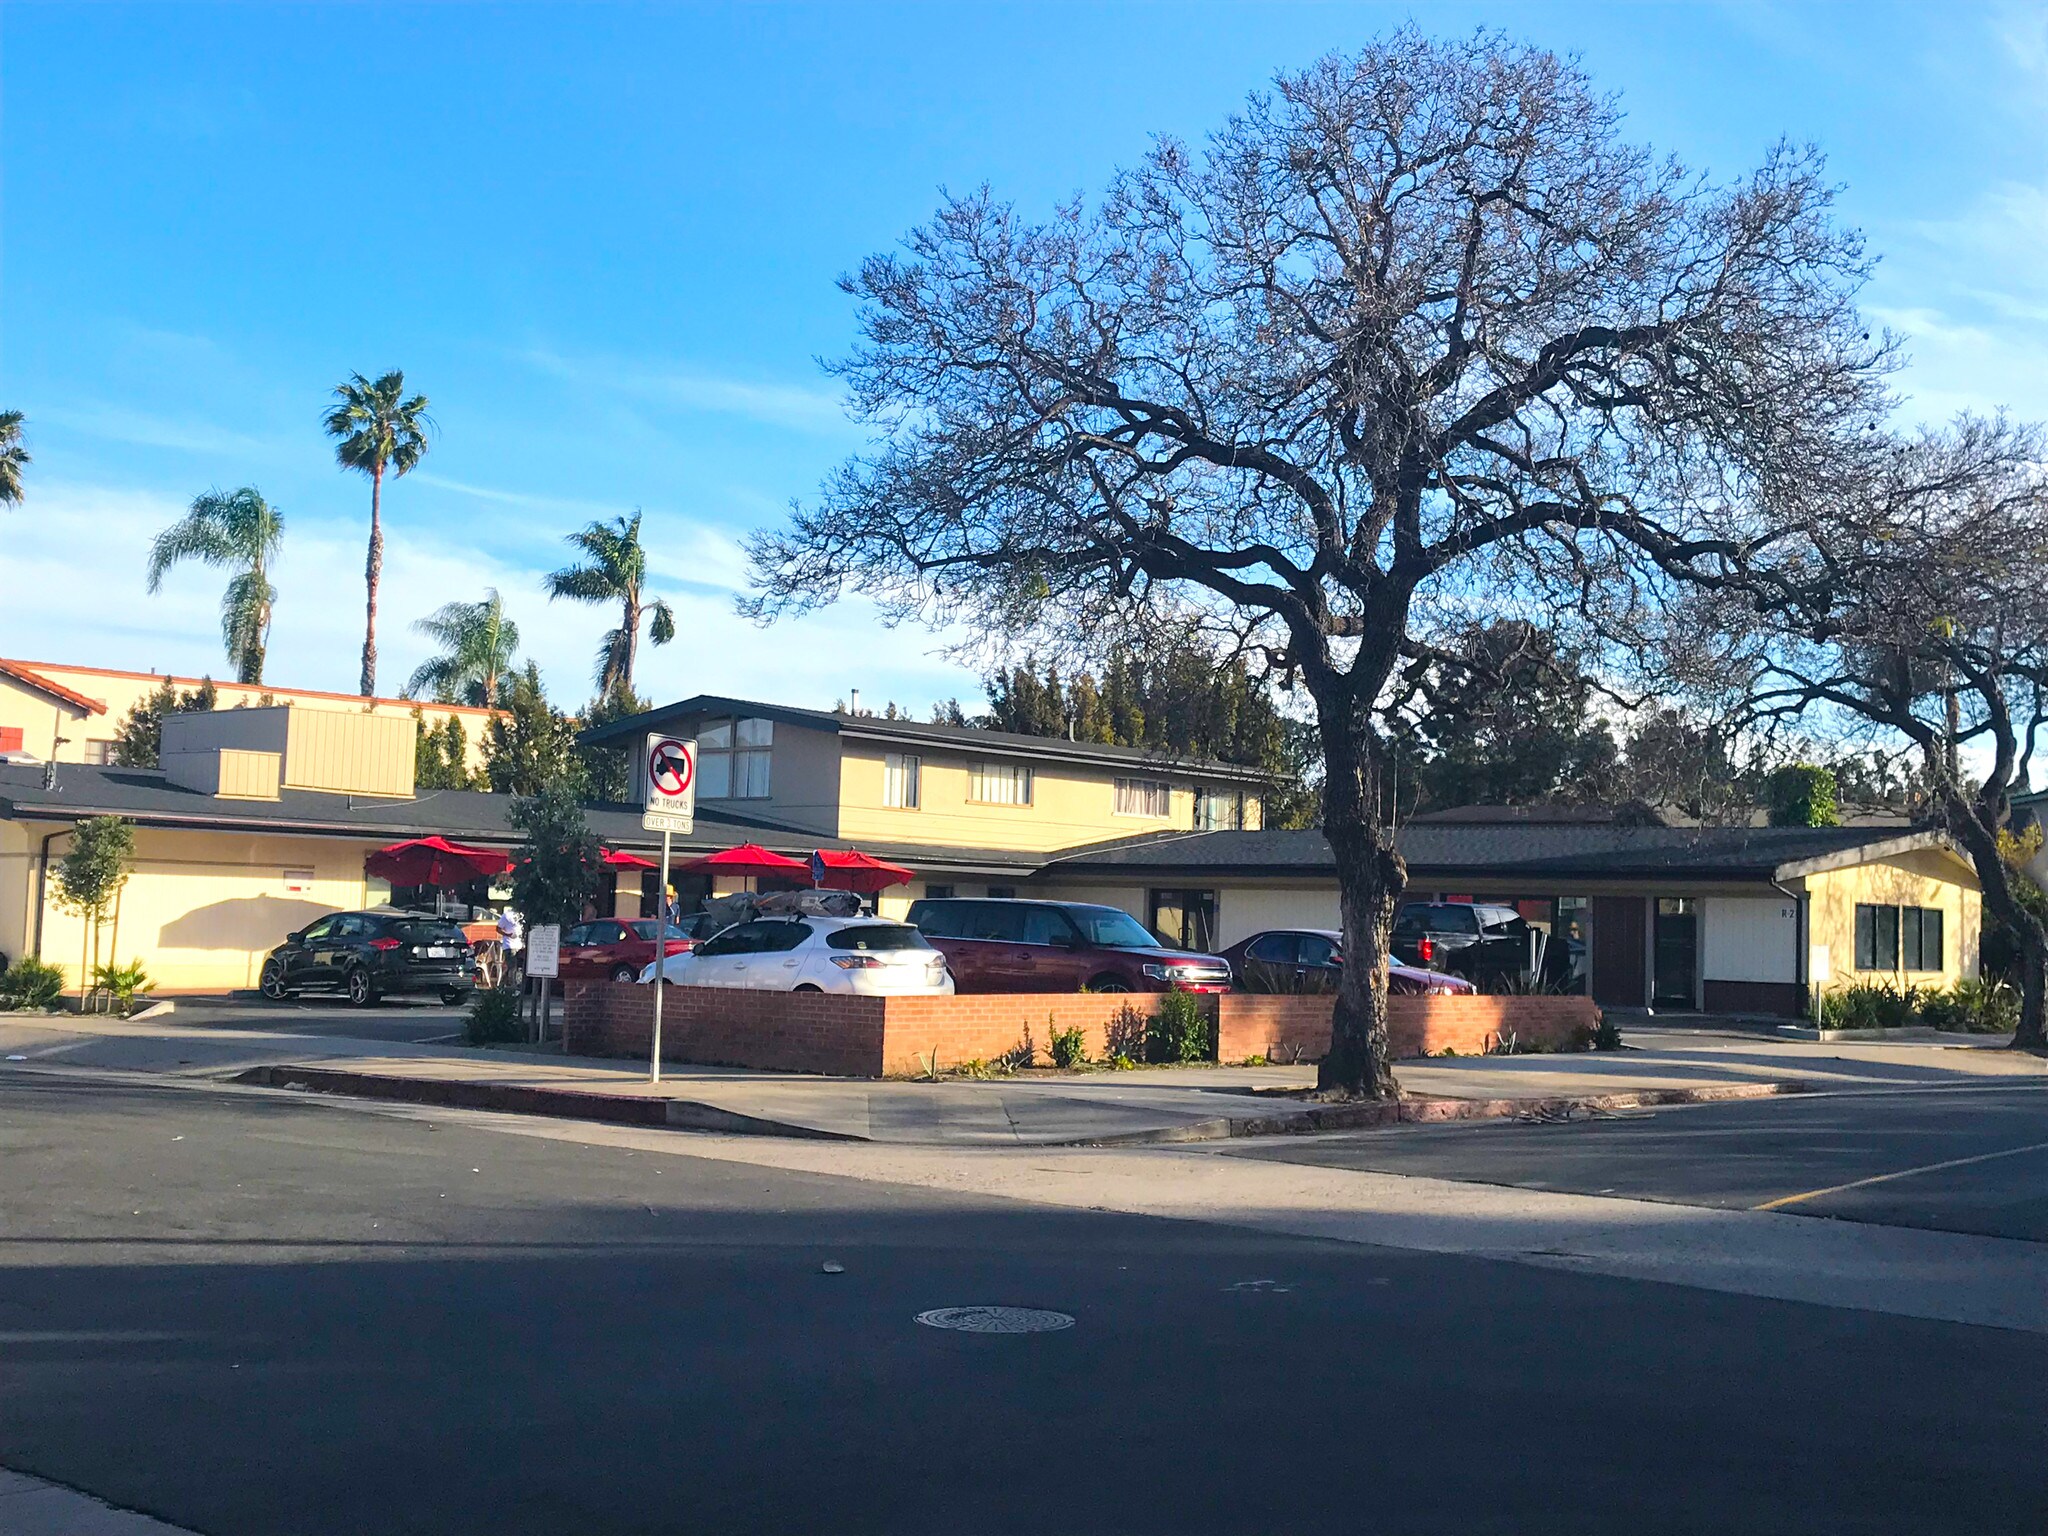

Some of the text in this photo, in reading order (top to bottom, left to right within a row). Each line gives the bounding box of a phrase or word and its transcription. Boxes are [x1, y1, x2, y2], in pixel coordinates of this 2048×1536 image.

[650, 797, 688, 810] NO TRUCKS
[646, 817, 664, 827] OVER
[674, 820, 690, 830] TONS
